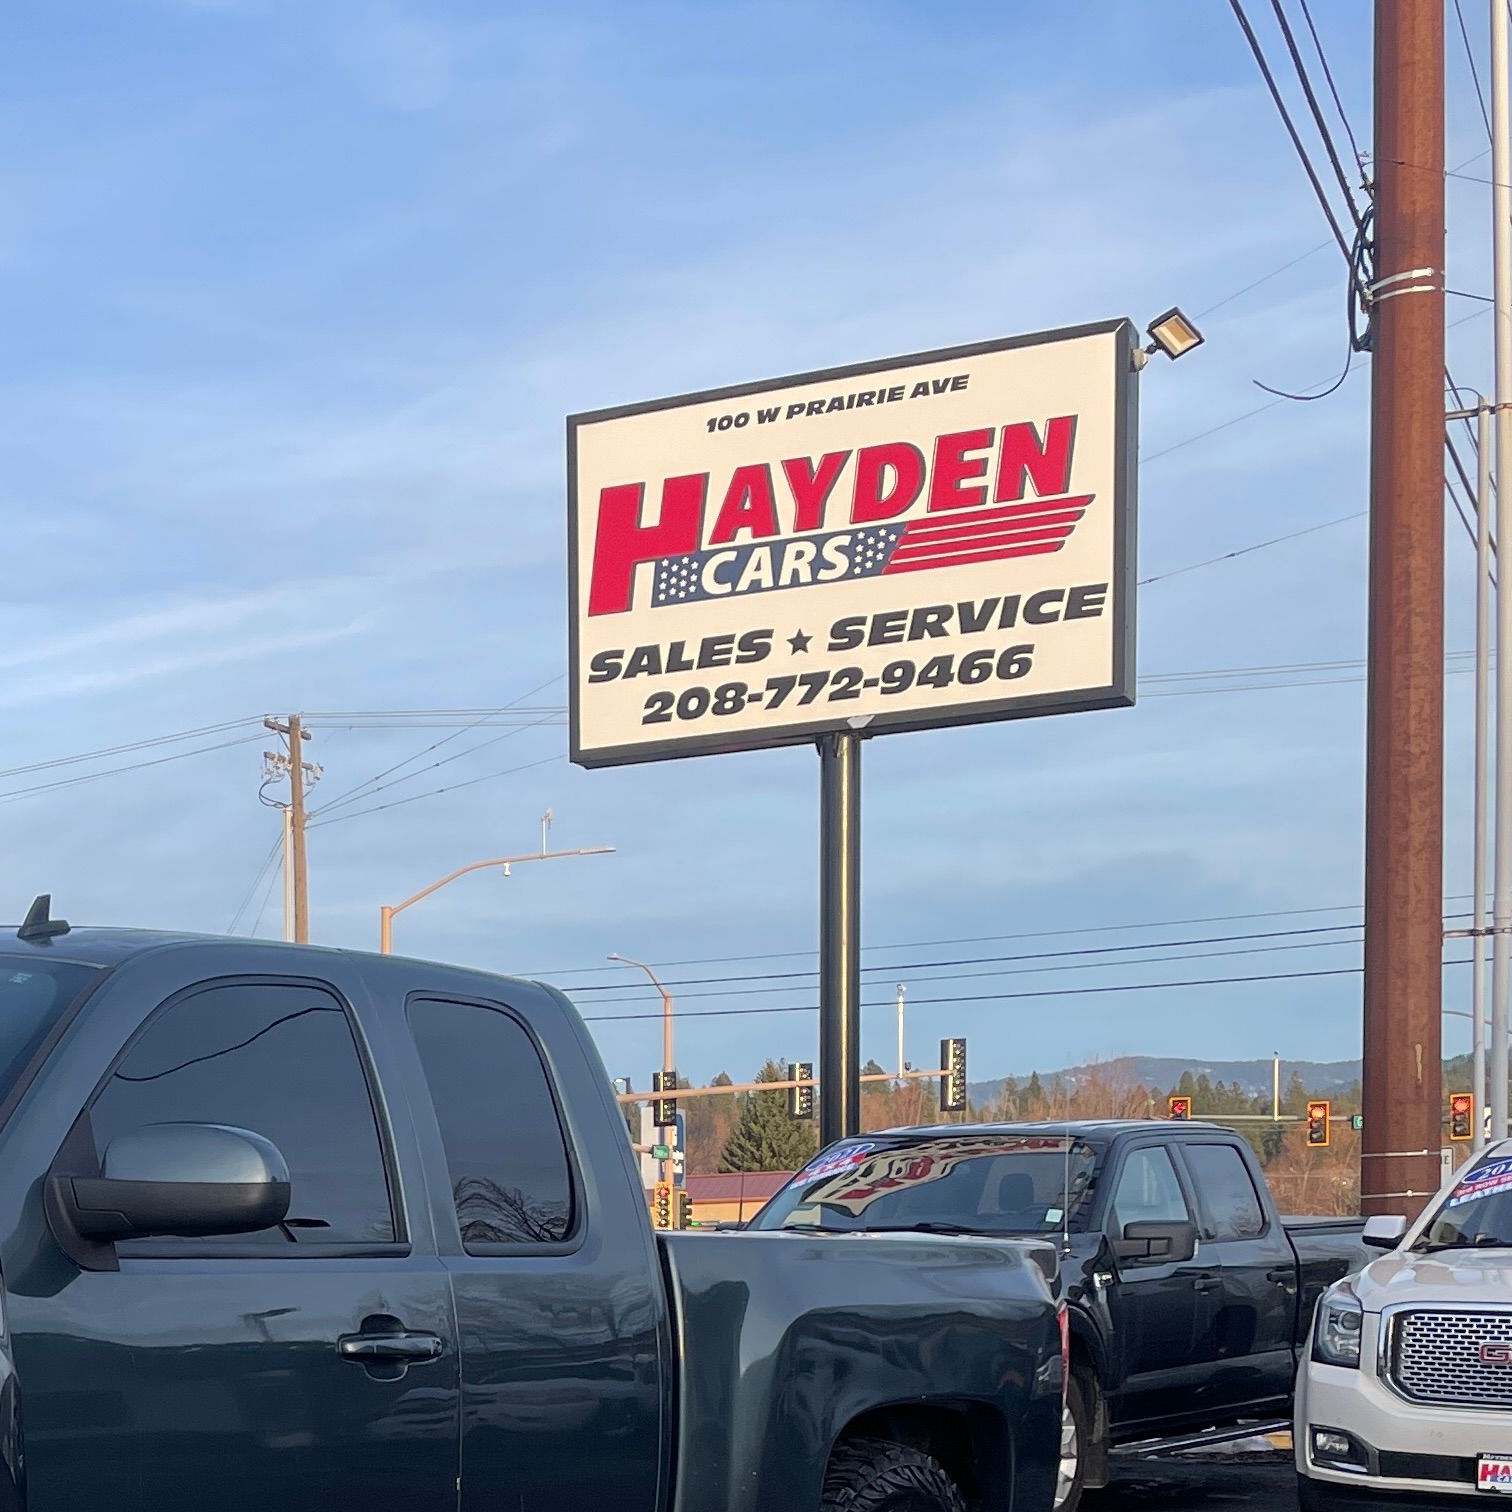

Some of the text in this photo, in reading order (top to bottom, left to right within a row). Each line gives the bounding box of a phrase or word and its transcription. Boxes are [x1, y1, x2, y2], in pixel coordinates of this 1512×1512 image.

[706, 374, 970, 433] 100 W PRAIRIE AVE
[589, 414, 1078, 617] HAYDEN
[700, 535, 854, 596] CARS
[588, 583, 1110, 684] SALES SERVICE
[641, 644, 1035, 726] 208-772-9466
